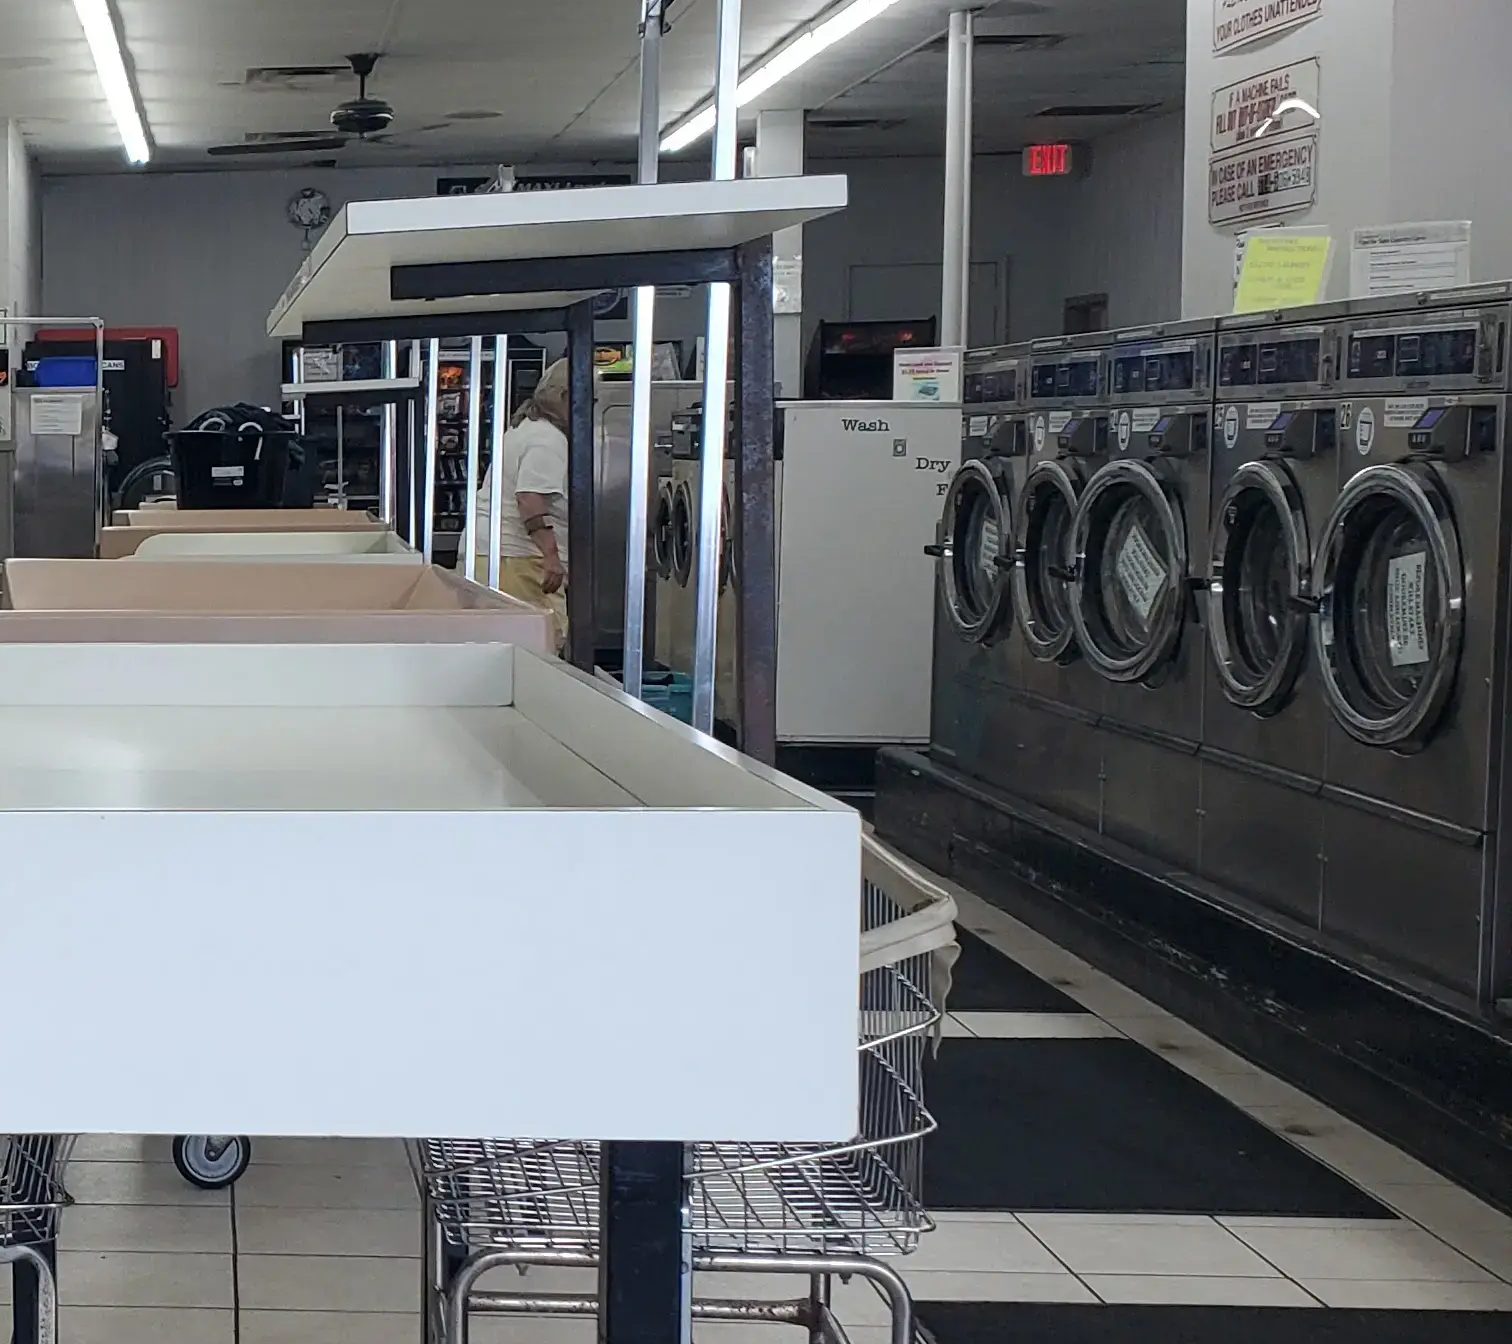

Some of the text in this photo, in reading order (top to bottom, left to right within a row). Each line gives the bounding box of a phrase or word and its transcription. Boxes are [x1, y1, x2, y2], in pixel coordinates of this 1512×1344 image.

[1215, 19, 1233, 44] YOUR
[1233, 3, 1264, 34] CLOTHES
[1241, 79, 1269, 101] MACHINE
[1270, 73, 1291, 94] FAILS
[1030, 144, 1067, 174] EXIT
[1210, 143, 1314, 188] IN CASE OF AN EMERGENCY
[1211, 184, 1236, 207] PLEASE
[1237, 178, 1256, 201] CALL
[101, 361, 125, 369] CANS
[841, 418, 890, 432] Wash
[915, 457, 951, 473] Dry
